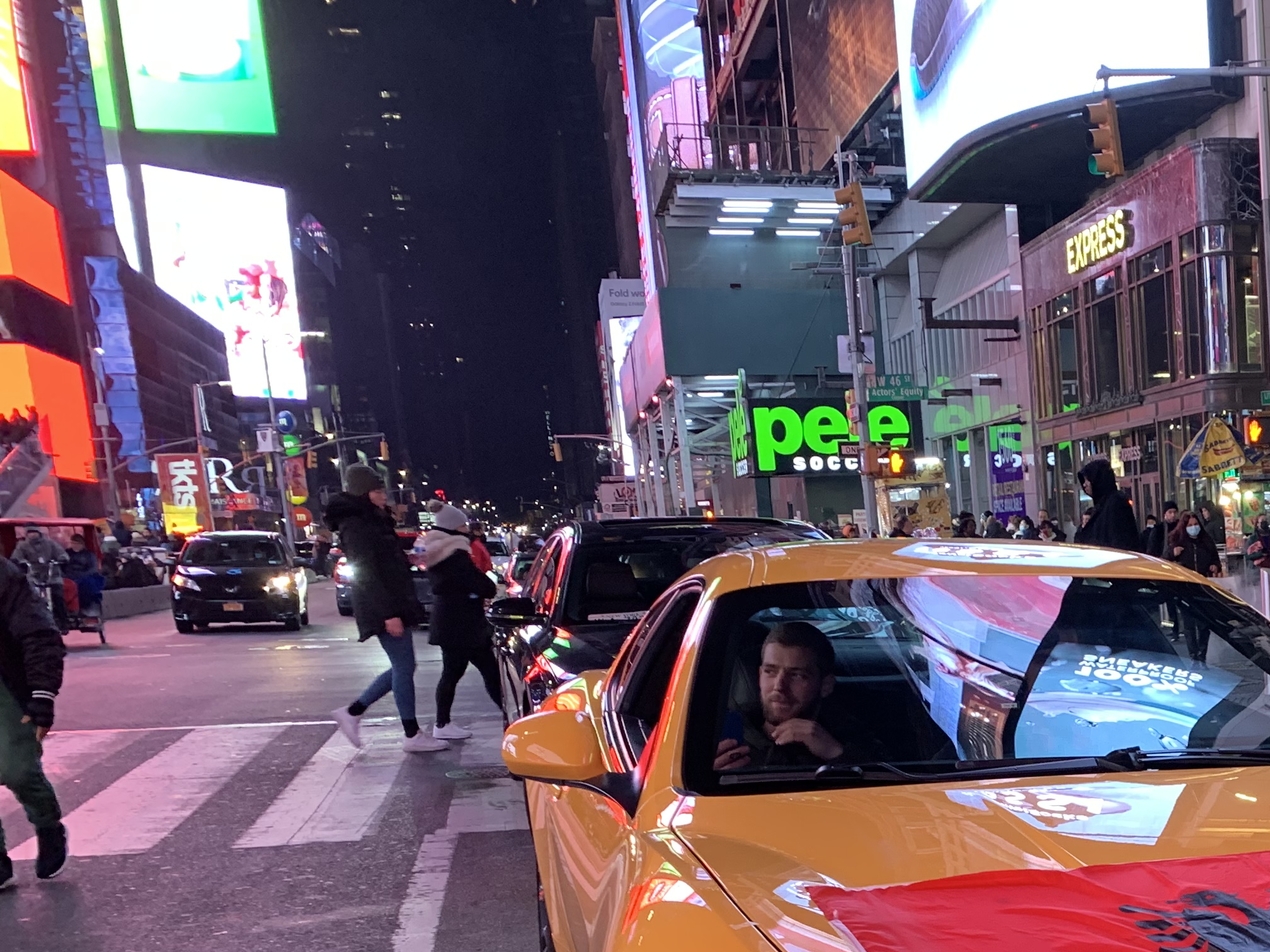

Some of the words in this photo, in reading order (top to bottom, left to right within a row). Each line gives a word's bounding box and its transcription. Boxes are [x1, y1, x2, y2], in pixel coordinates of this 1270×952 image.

[1065, 209, 1126, 275] EXPRESS
[608, 288, 629, 298] Fold
[890, 375, 901, 387] 46
[900, 387, 924, 397] Equity
[1202, 456, 1244, 475] SABRETT
[168, 458, 200, 509] tkts
